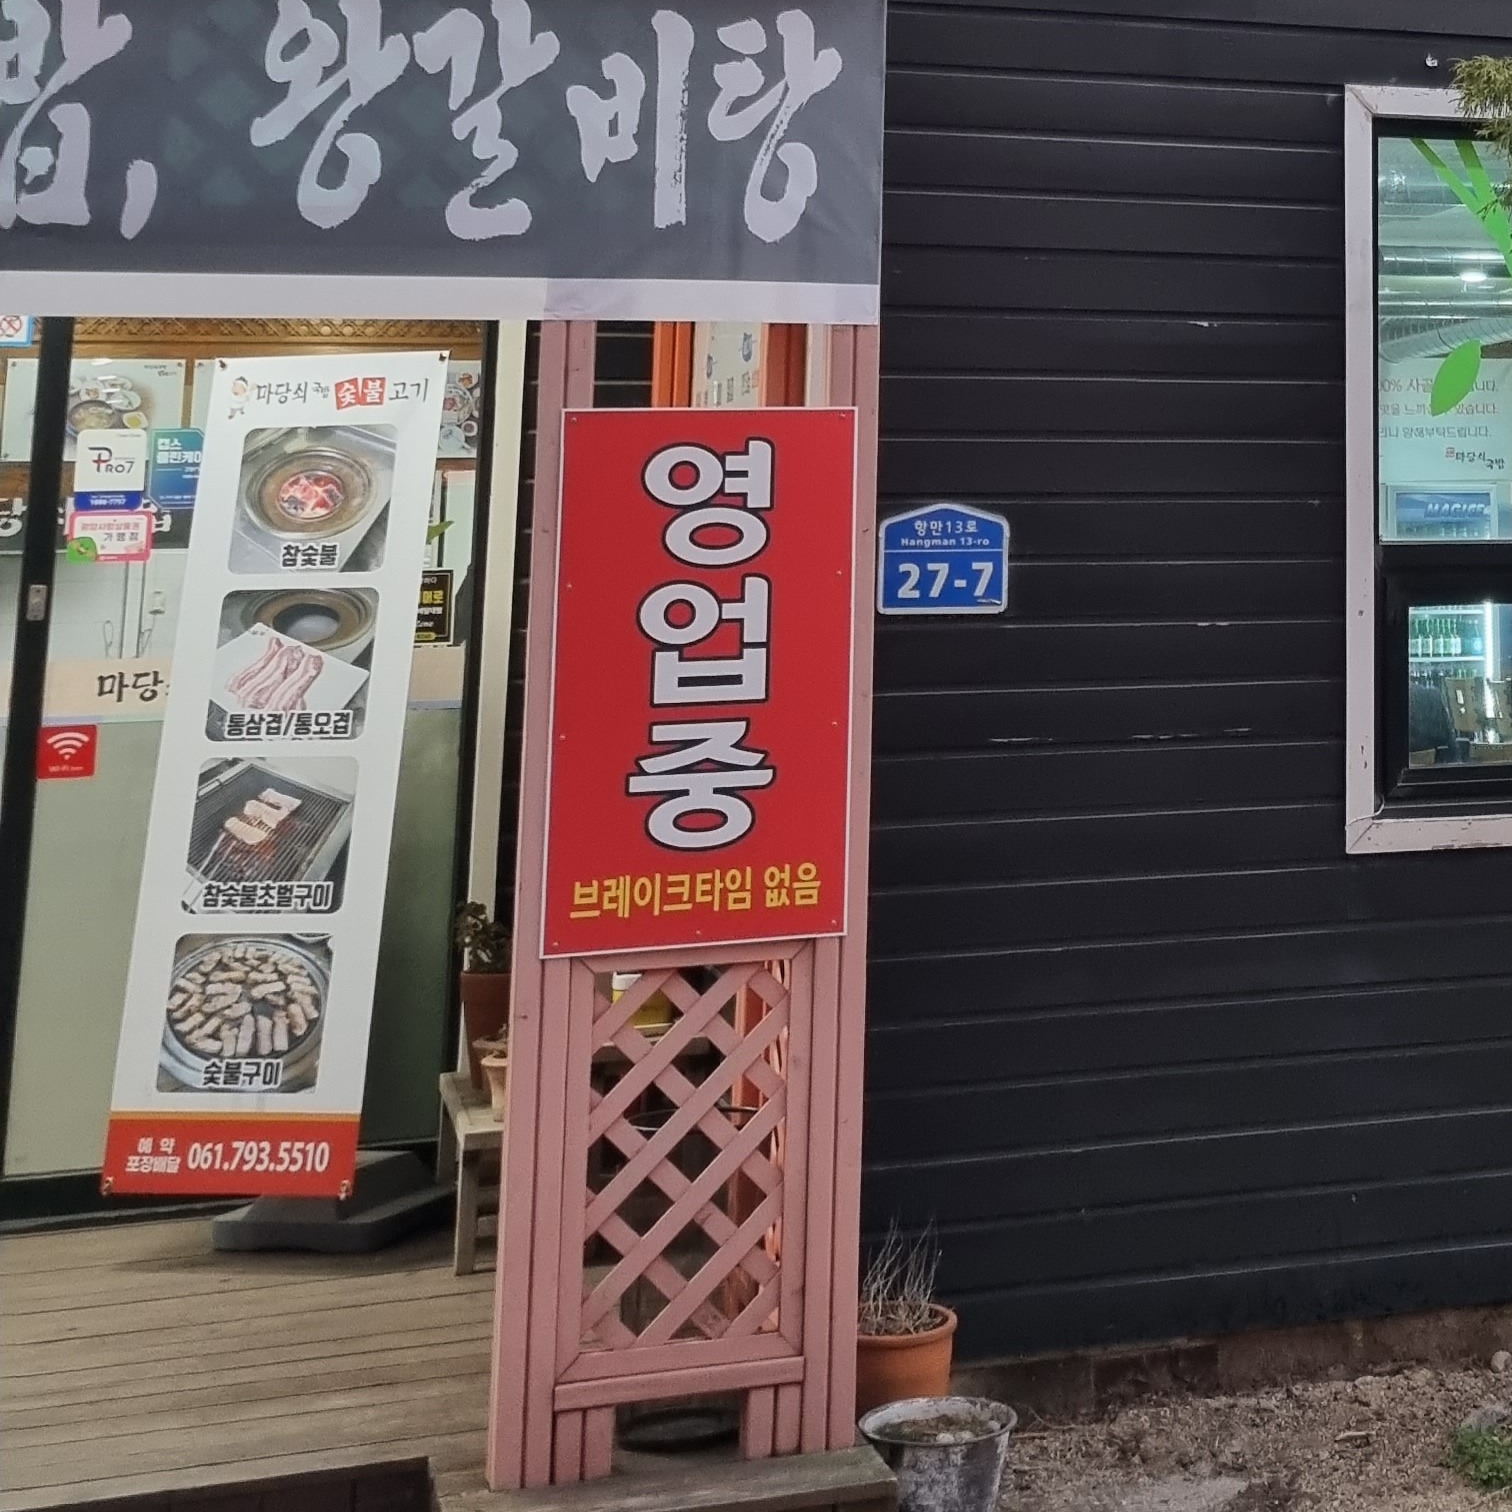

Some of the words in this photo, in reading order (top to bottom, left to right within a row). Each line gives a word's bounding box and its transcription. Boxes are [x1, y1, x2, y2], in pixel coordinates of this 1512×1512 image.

[256, 381, 308, 405] 마당쇠
[901, 537, 956, 548] Hangman
[961, 537, 990, 546] 13-ro
[914, 520, 978, 536] 항만13로
[281, 543, 338, 568] 참숯불
[897, 562, 993, 599] 27-7
[627, 438, 774, 851] 영업중
[97, 670, 170, 702] 마당
[569, 867, 753, 920] 브레이크타임
[763, 862, 822, 908] 없음
[202, 1060, 281, 1087] 숯불구이
[187, 1141, 330, 1173] 061.793.5510
